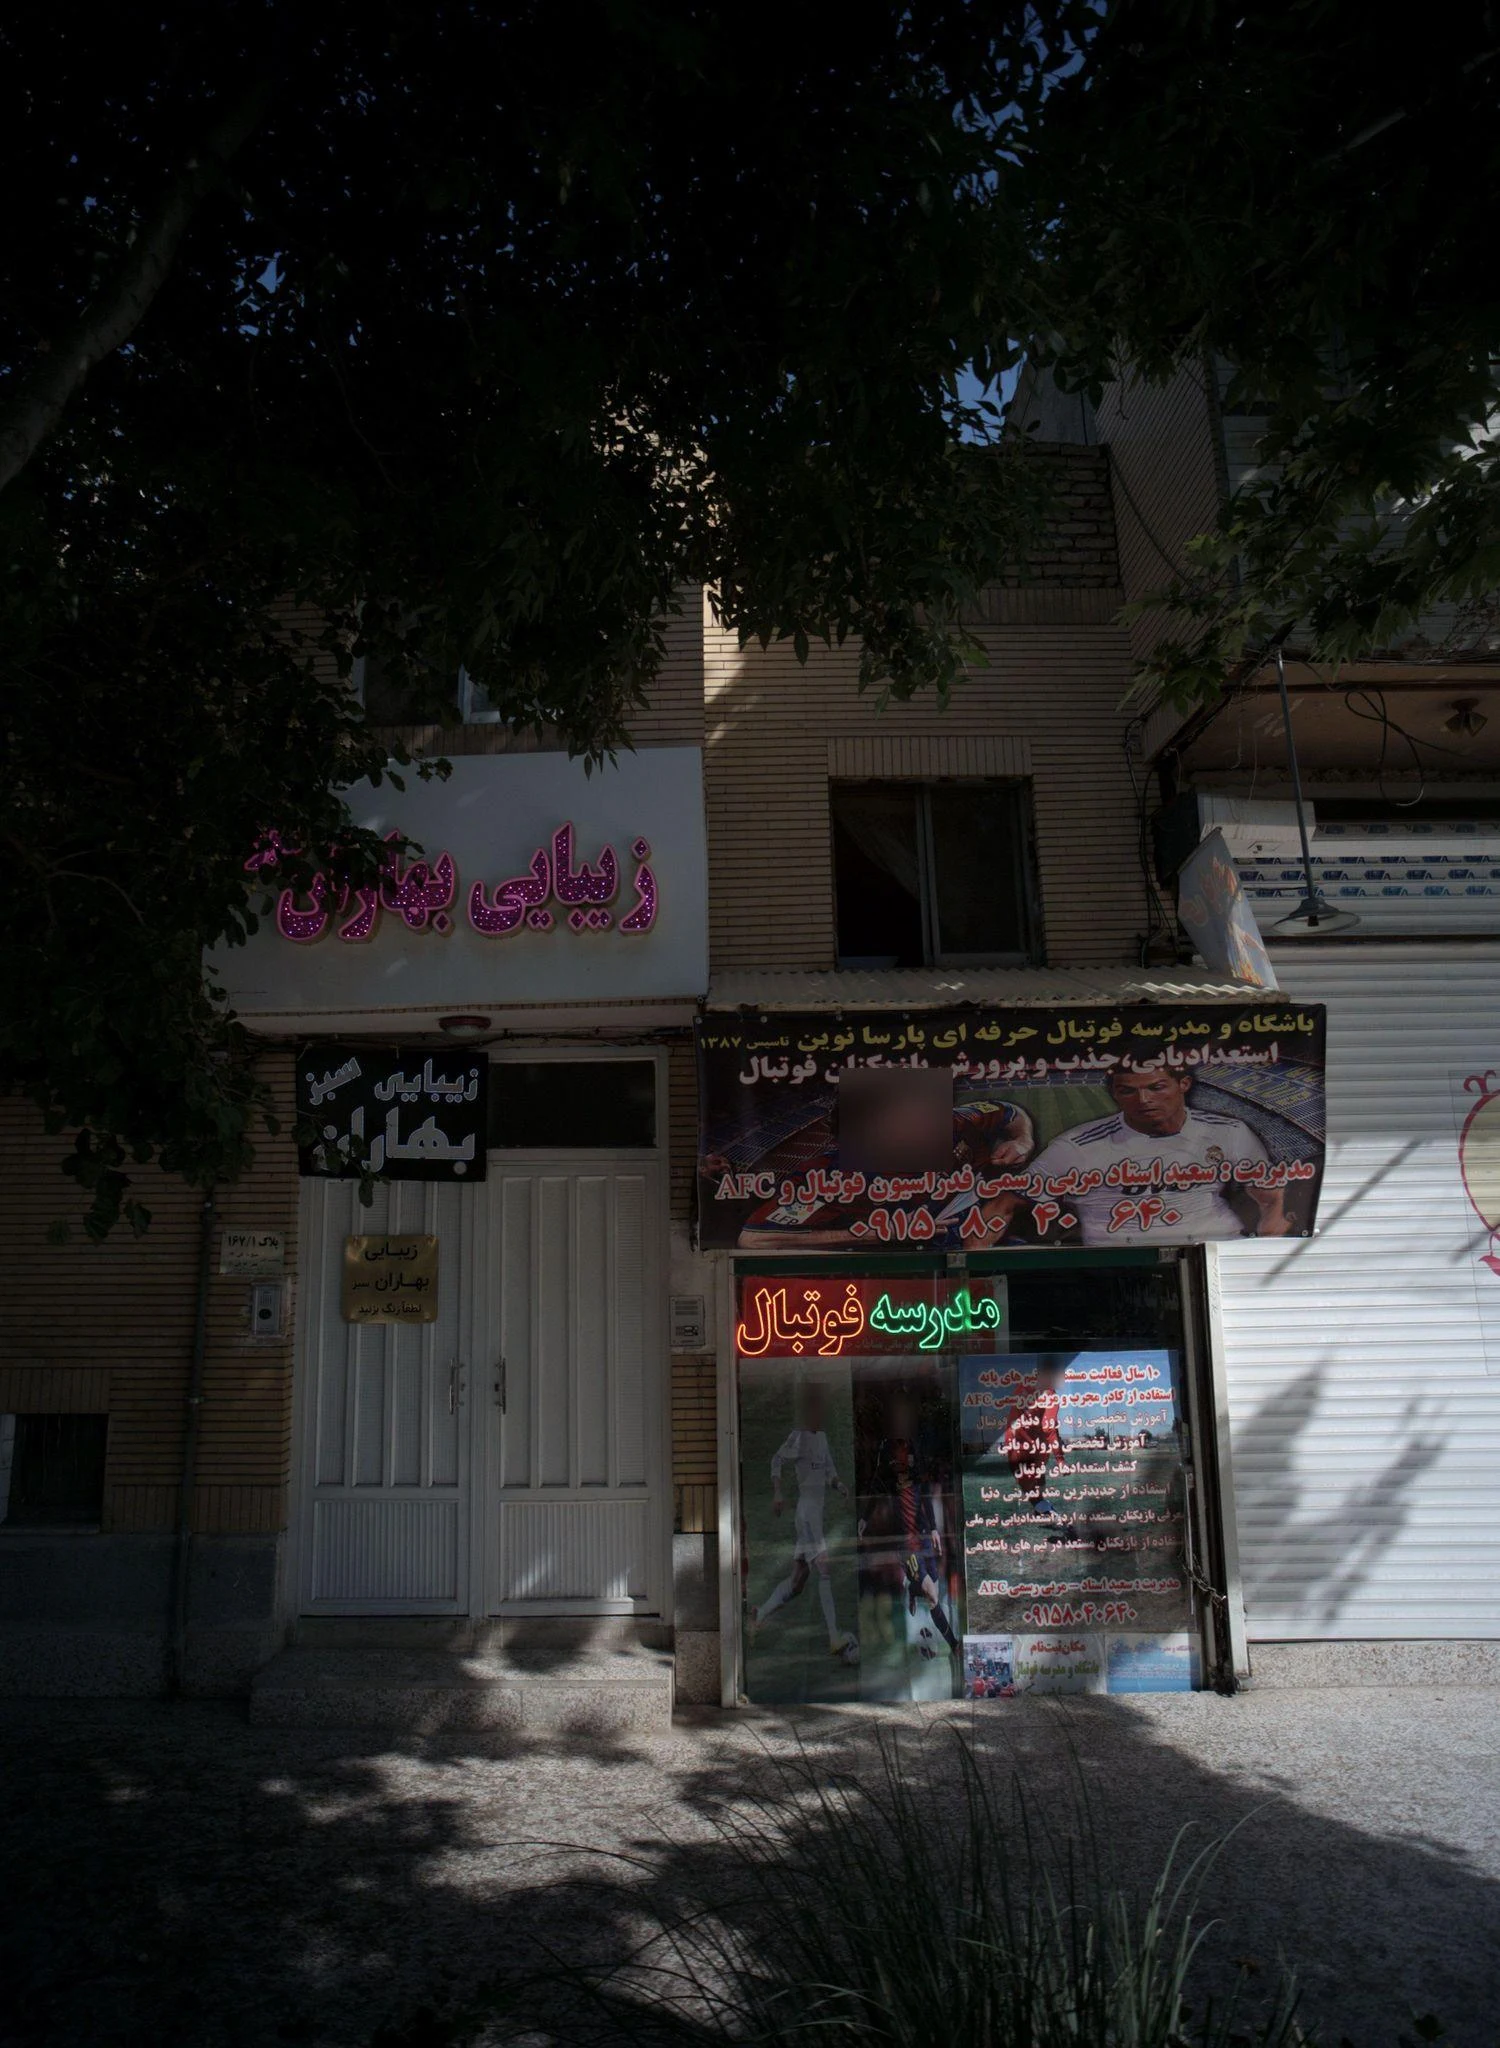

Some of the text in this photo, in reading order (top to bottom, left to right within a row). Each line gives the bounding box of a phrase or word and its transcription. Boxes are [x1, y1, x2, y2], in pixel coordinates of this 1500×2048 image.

[467, 821, 658, 939] زیبایی
[700, 1013, 1315, 1051] باشگاه و مدرسه فوتبال حرفه ای پارسا نوین تاسیس ۱۳۸۷
[739, 1054, 817, 1084] فوتبال
[953, 1051, 1031, 1080] پرورش
[1036, 1054, 1047, 1071] و
[305, 1056, 479, 1106] زیبایی سبز
[312, 1106, 476, 1175] بهاران
[1047, 1167, 1101, 1195] مربی
[1106, 1158, 1163, 1187] استاد
[1165, 1160, 1216, 1189] سعید
[1235, 1159, 1315, 1187] مدیریت
[714, 1173, 775, 1200] AFC
[798, 1167, 865, 1205] فوتبال
[868, 1164, 973, 1202] فدراسیون
[977, 1168, 1044, 1197] رسمی
[779, 1181, 795, 1205] و
[960, 1205, 1007, 1241] ۸۰
[1032, 1201, 1078, 1235] ۴۰
[1108, 1197, 1183, 1232] ۶۴۰
[259, 1237, 278, 1249] پلاک
[365, 1242, 417, 1261] زیبایی
[352, 1272, 429, 1291] بهاران سبز
[737, 1283, 1001, 1356] مدرسه فوتبال
[980, 1370, 998, 1385] پایه
[1001, 1371, 1021, 1385] های
[1090, 1366, 1122, 1383] فعالیت
[1125, 1367, 1145, 1383] سال
[964, 1389, 1175, 1410] استفاده از کادر مجرب و مربیان رسمی AFC
[1010, 1414, 1040, 1431] دنیای
[1042, 1417, 1060, 1429] روز
[998, 1433, 1146, 1455] آموزش تخصصی دروازه بانی
[1014, 1460, 1138, 1479] کشف استعدادهای فوتبال
[980, 1486, 1000, 1500] دنیا
[1042, 1486, 1060, 1499] متد
[1063, 1485, 1117, 1502] جدیدترین
[1119, 1483, 1131, 1499] از
[965, 1513, 984, 1527] ملی
[986, 1514, 999, 1527] تیم
[966, 1538, 1008, 1554] باشگاهی
[1010, 1539, 1031, 1554] های
[978, 1580, 1007, 1595] AFC
[1008, 1581, 1039, 1598] رسمی
[1042, 1583, 1066, 1597] مربی
